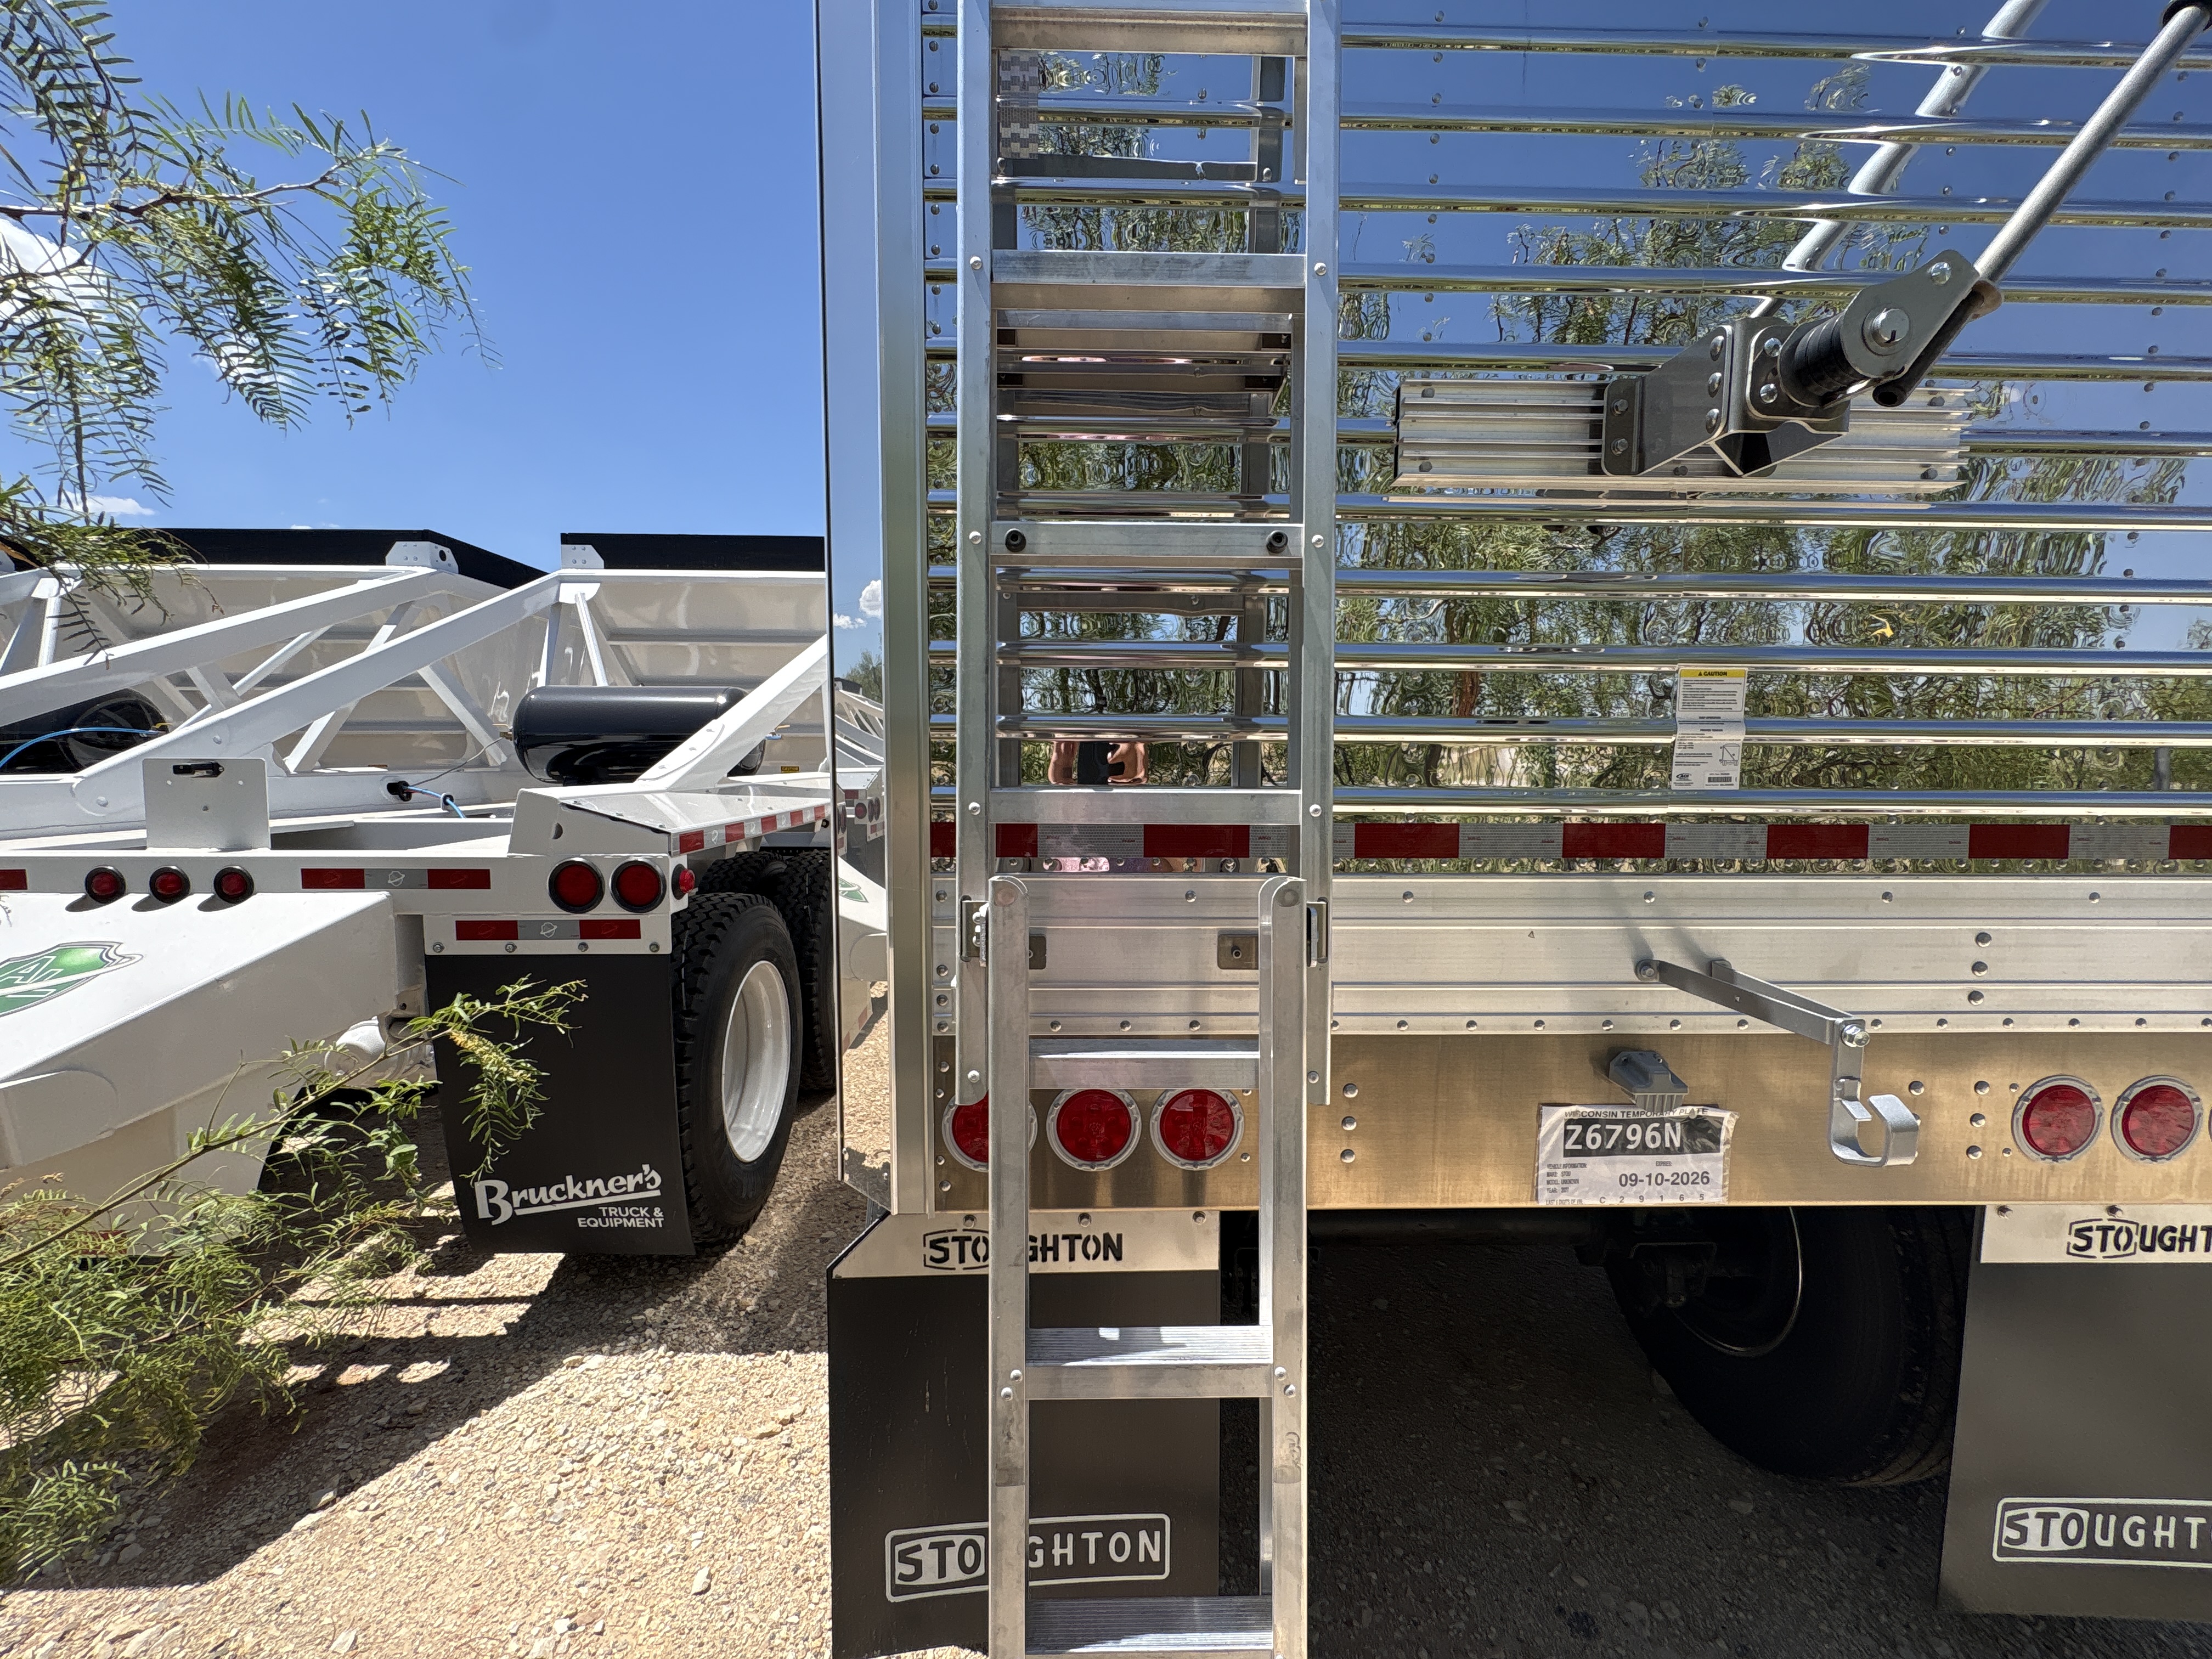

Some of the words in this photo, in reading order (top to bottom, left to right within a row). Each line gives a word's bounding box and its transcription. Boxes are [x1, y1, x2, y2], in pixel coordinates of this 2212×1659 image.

[1565, 1121, 1681, 1150] Z6796N
[1618, 1171, 1710, 1187] 09-10-2026
[474, 1164, 662, 1226] Bruckner's
[577, 1217, 664, 1228] EQUIPMENT
[599, 1206, 648, 1218] TRUCK
[652, 1206, 664, 1218] &
[929, 1232, 1122, 1264] STOGHTON
[2004, 1511, 2212, 1549] STOUGHT
[898, 1529, 1160, 1582] STOGHTON
